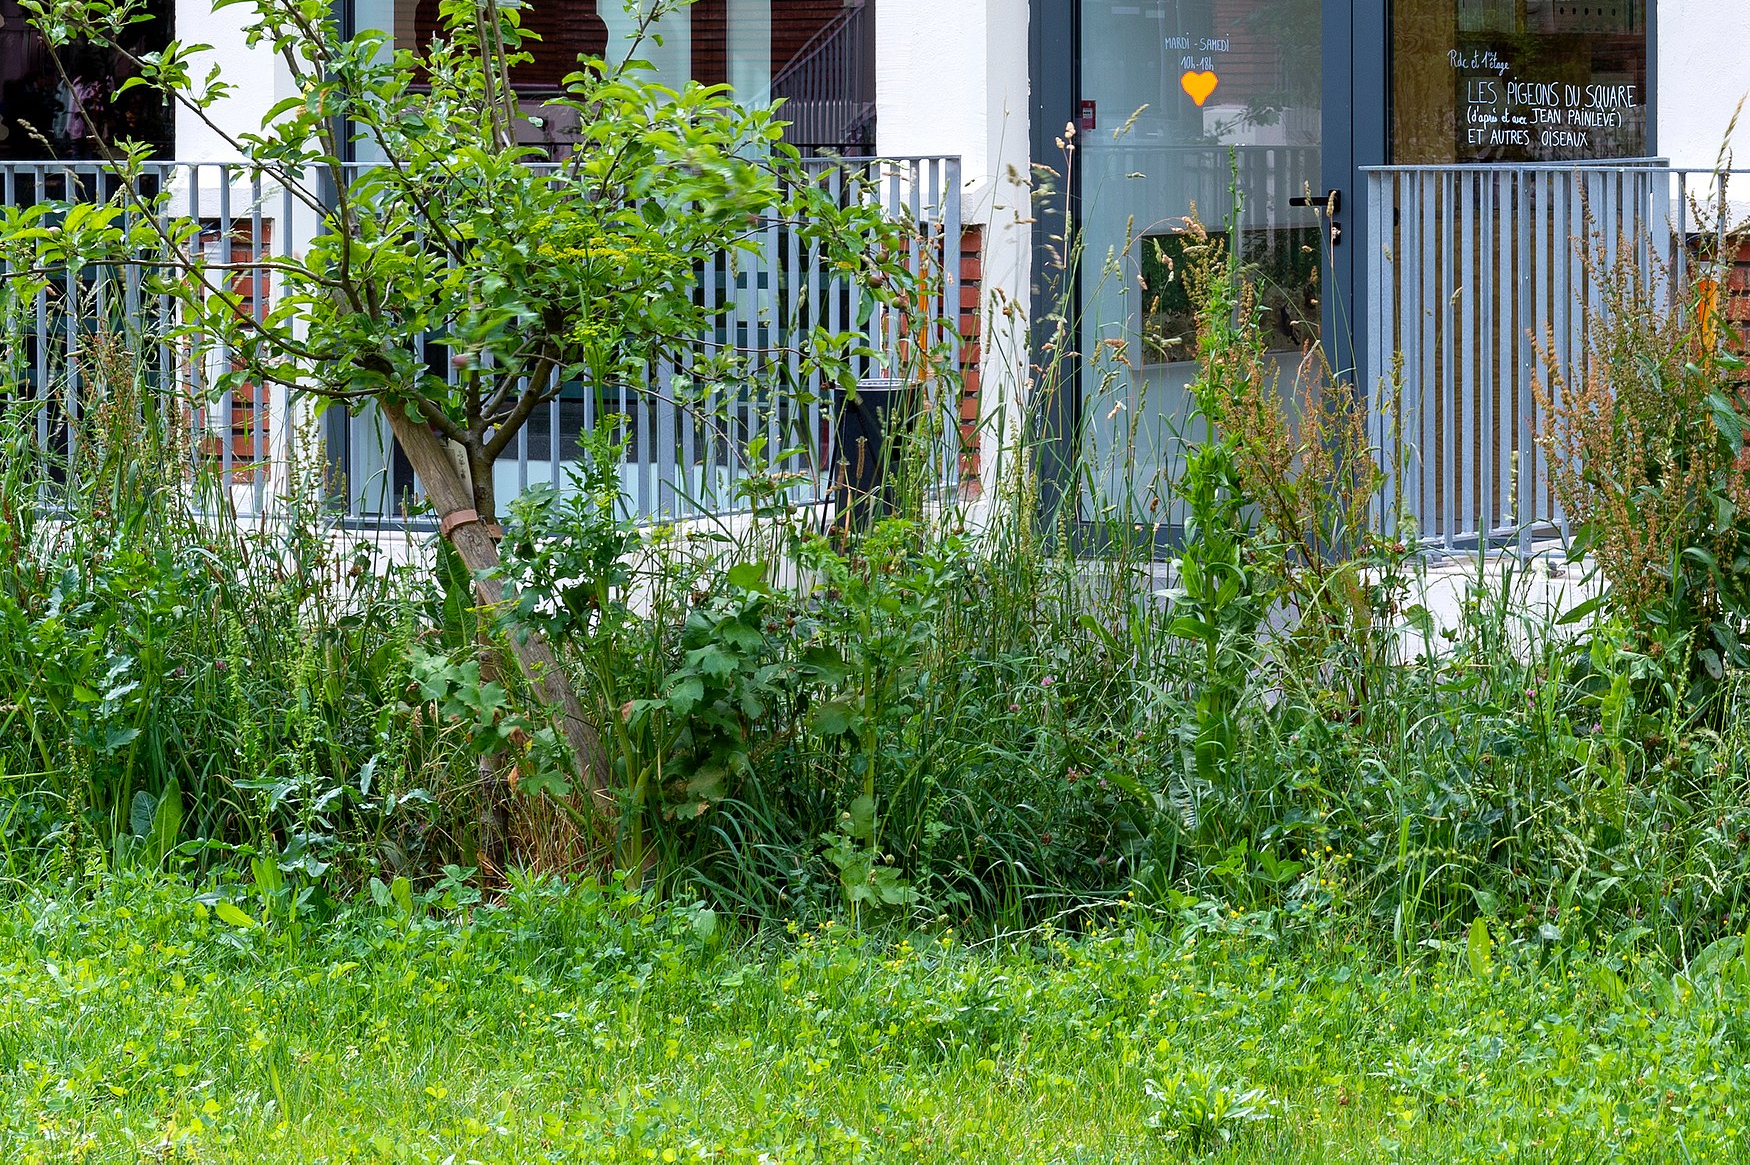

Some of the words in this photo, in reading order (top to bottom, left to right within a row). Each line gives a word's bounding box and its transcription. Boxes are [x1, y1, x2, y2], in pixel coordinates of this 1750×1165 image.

[1467, 80, 1498, 105] LES
[1565, 84, 1580, 107] DU
[1584, 84, 1637, 113] SQUARE
[1529, 108, 1561, 124] JEAN
[1467, 128, 1485, 145] ET
[1489, 129, 1530, 146] AUTRES
